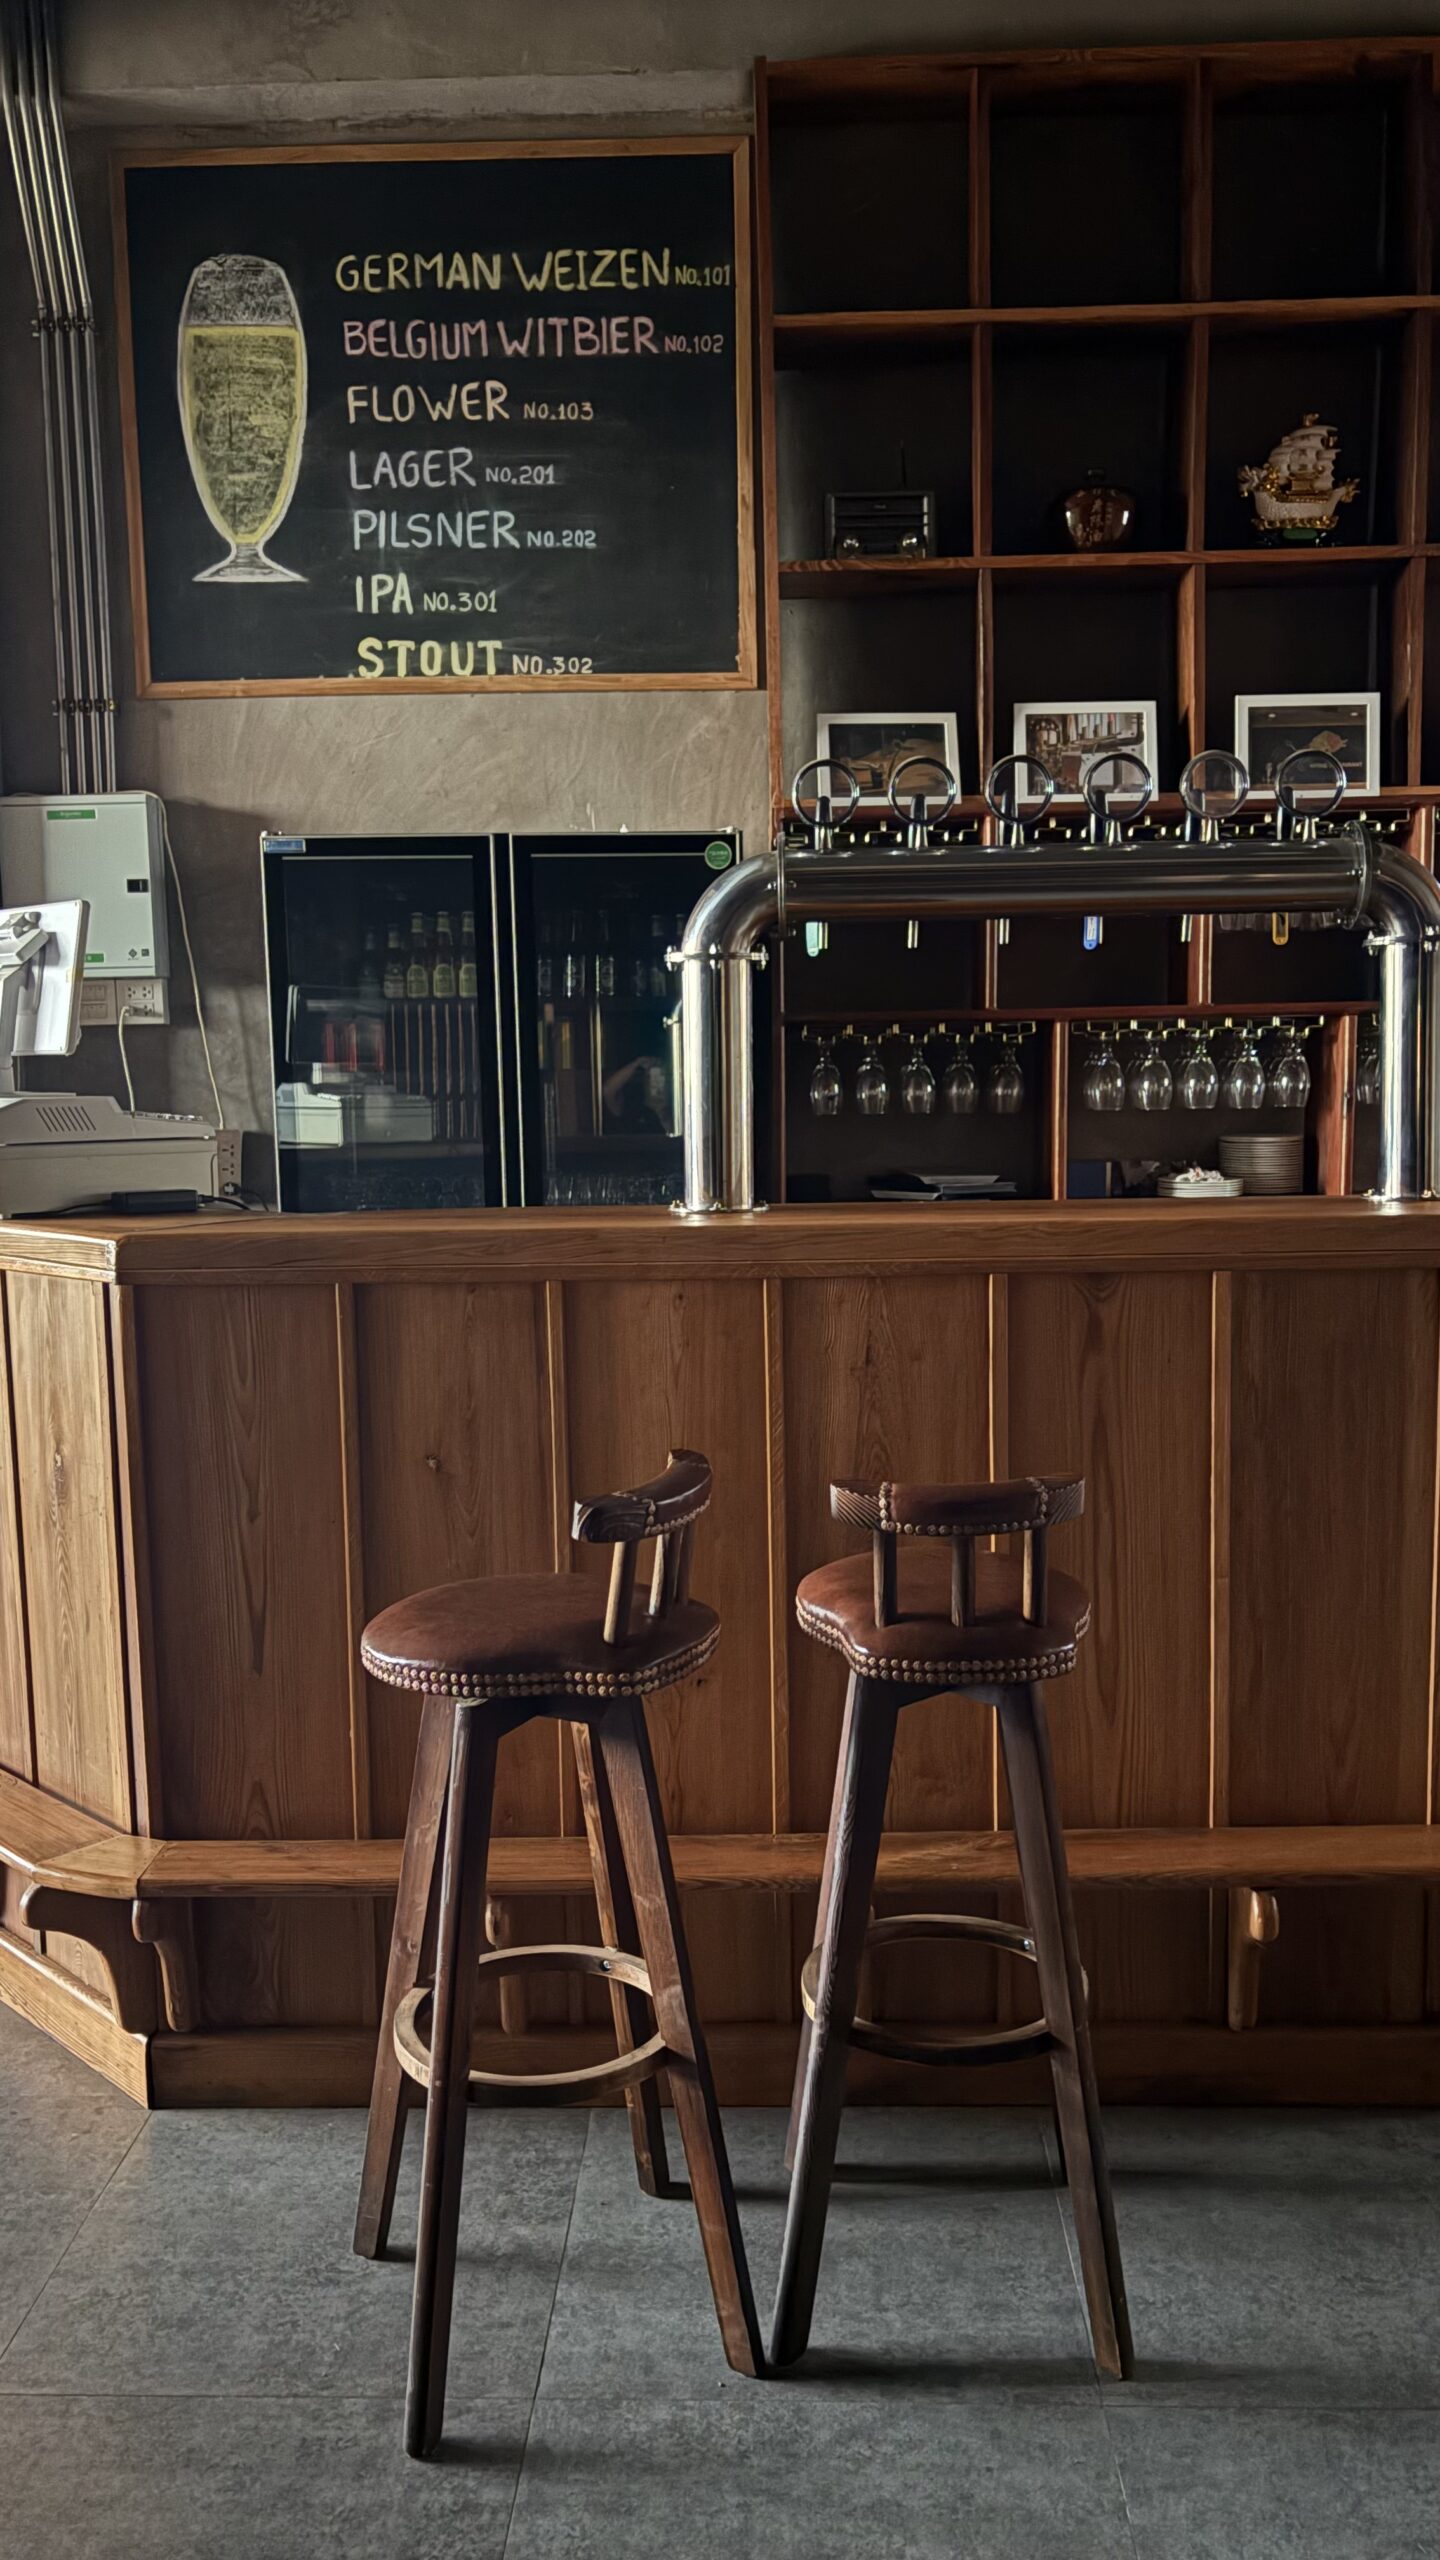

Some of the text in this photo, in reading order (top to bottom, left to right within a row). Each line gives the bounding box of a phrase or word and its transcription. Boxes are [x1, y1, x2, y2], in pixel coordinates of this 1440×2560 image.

[336, 252, 501, 291] GERMAN
[512, 248, 669, 291] WEIZEN
[344, 317, 723, 360] BELGIUM WITBIER NO.102
[347, 381, 593, 423] FLOWER NO.103
[350, 447, 555, 489] LAGER NO.201
[354, 510, 596, 550] PILSNER NO.202
[356, 573, 496, 614] IPA NO.301
[356, 637, 595, 677] STOUT NO.302
